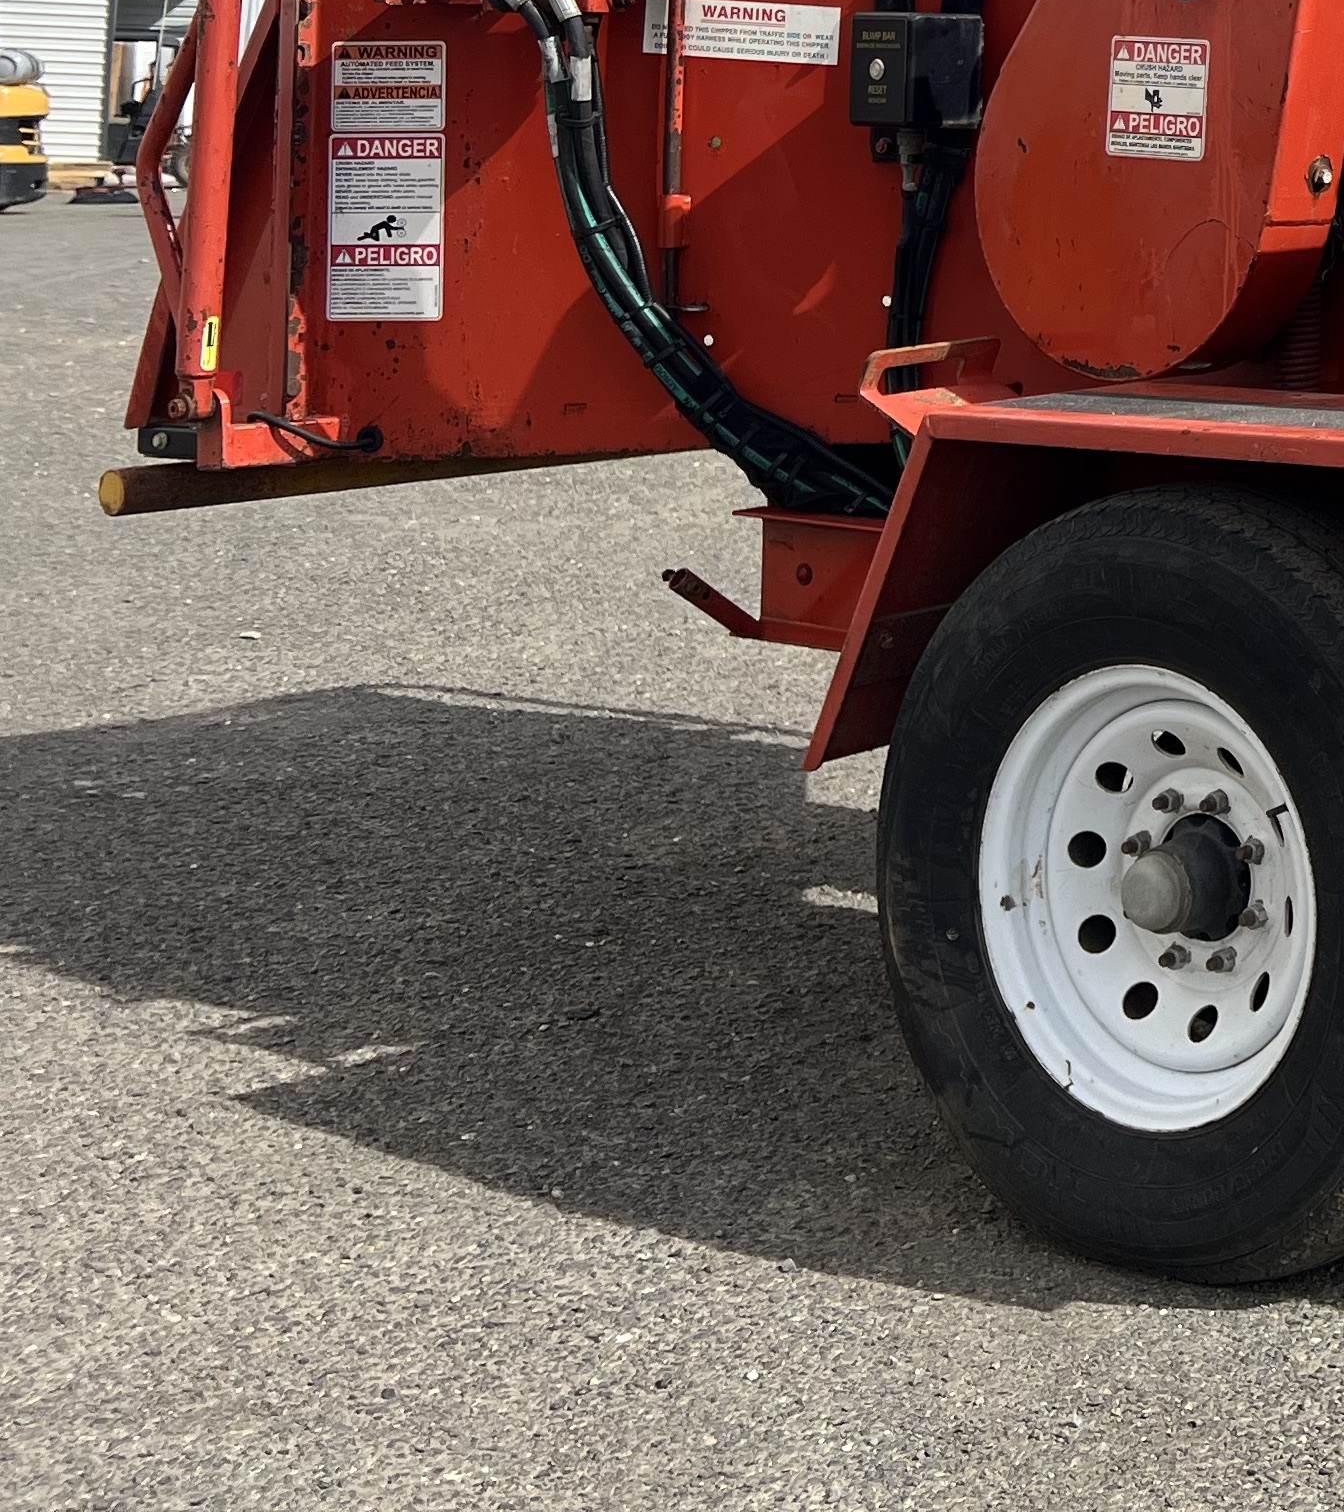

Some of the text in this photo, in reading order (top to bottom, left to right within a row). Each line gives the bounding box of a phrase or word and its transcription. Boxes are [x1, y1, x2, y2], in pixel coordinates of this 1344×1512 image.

[702, 4, 786, 22] WARNING
[358, 47, 437, 58] WARNING
[1134, 43, 1202, 64] DANGER
[353, 87, 438, 99] ADVERTENCIA
[1129, 114, 1200, 136] PELIGRO
[357, 140, 439, 156] DANGER
[355, 247, 437, 264] PELIGRO
